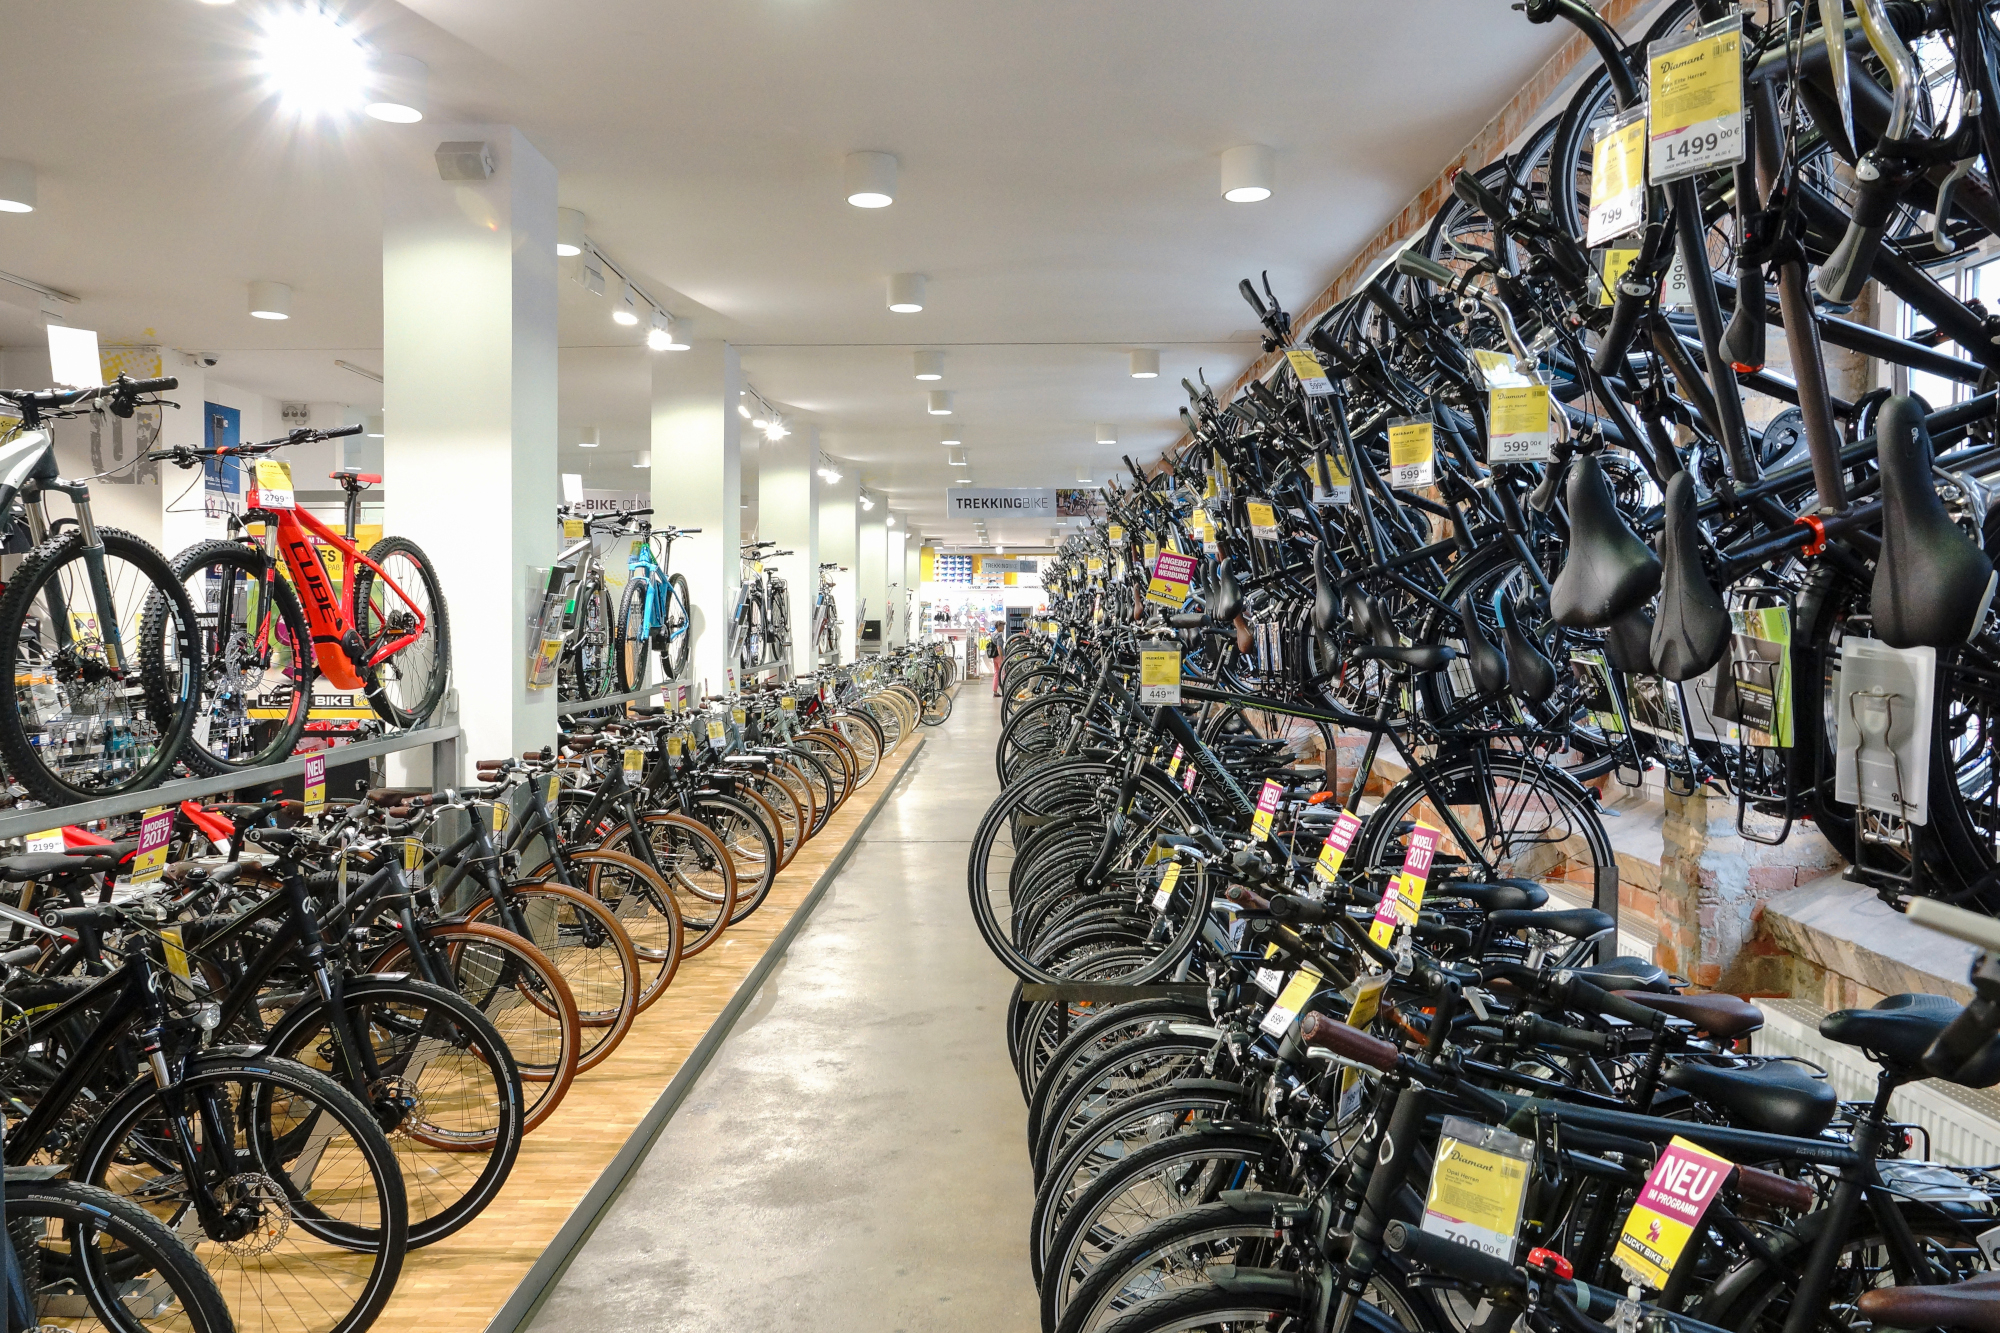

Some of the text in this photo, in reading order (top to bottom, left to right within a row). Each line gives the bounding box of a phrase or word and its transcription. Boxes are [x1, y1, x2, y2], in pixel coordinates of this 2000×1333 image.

[1661, 53, 1705, 74] Diamant
[1666, 132, 1718, 162] 1499
[1601, 206, 1622, 226] 799
[1672, 264, 1686, 290] 999
[1309, 382, 1322, 390] 599
[1504, 441, 1529, 452] 599
[1400, 470, 1420, 480] 599
[264, 494, 284, 502] 2799
[956, 498, 1048, 508] TREKKINGBIKE
[1160, 556, 1192, 568] ANGEBOT
[290, 541, 336, 624] CUBE
[1158, 569, 1189, 581] WERBUNG
[314, 696, 352, 706] BIKE
[306, 758, 324, 778] NEU
[1194, 750, 1252, 815] MAXIM
[1262, 786, 1280, 804] NEU
[144, 816, 170, 832] MODELL
[1336, 818, 1356, 832] ANGEBOT
[142, 827, 170, 849] 2017
[1330, 834, 1349, 848] WERBUNG
[1412, 833, 1433, 850] MODELL
[32, 842, 54, 852] 2199
[1407, 846, 1430, 870] 2017
[1270, 1012, 1284, 1026] 699
[272, 1070, 312, 1090] MARATHON
[1451, 1150, 1494, 1172] Diamant
[1446, 1168, 1460, 1178] Opal
[1460, 1171, 1480, 1183] Herren
[1654, 1154, 1718, 1202] NEU
[28, 1194, 78, 1206] SCHWALBE
[1647, 1188, 1699, 1217] IM PROGRAMM
[112, 1214, 158, 1248] MARATHON
[1623, 1234, 1662, 1264] LUCKY BIKE
